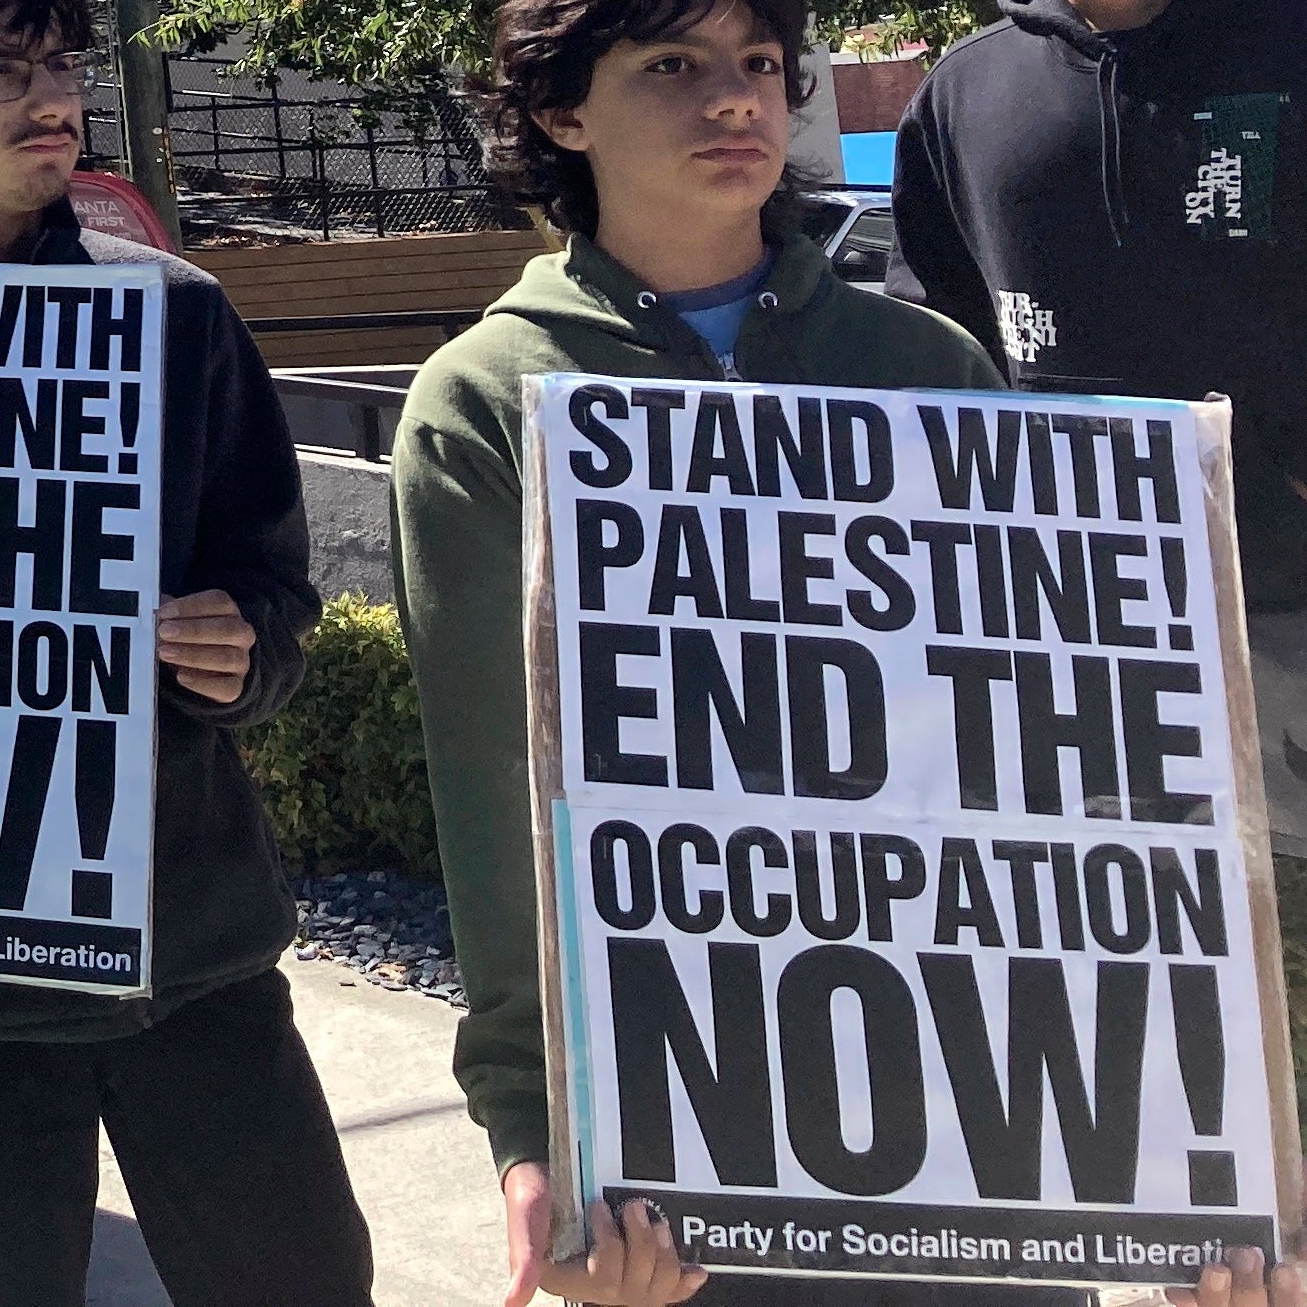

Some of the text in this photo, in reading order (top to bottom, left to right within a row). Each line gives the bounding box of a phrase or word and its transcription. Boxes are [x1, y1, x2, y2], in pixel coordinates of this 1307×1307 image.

[1197, 164, 1215, 219] CITY
[1210, 147, 1227, 193] THE
[1224, 154, 1242, 219] TURN
[74, 200, 120, 214] ANTA
[87, 216, 126, 227] FIRST
[569, 384, 1181, 524] STAND WITH
[576, 499, 1194, 651] PALESTINE!
[581, 621, 1215, 825] END THE
[590, 820, 1229, 956] OCCUPATION
[607, 937, 1238, 1206] NOW!
[682, 1215, 1231, 1267] Party for Socialism and Liberati
